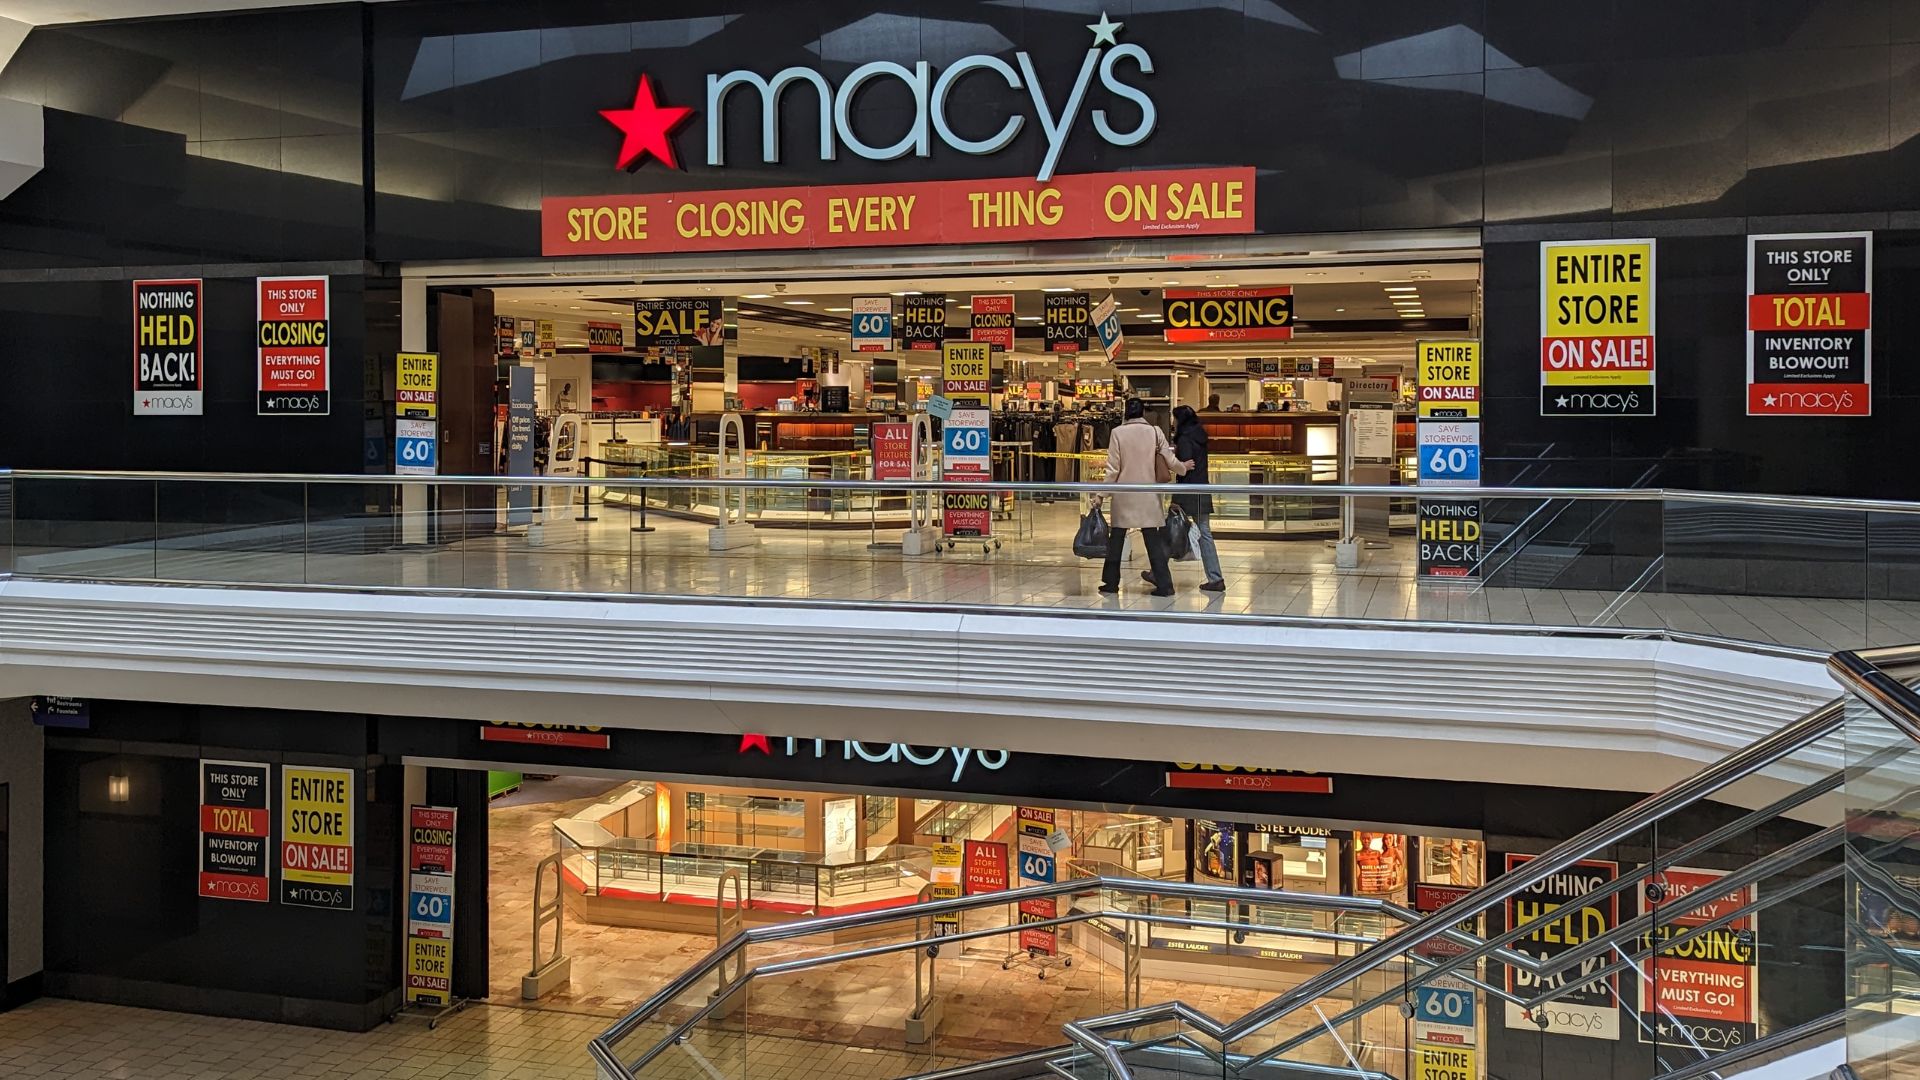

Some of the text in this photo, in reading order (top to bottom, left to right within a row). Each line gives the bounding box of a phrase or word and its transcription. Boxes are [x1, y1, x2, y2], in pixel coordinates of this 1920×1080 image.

[707, 12, 1156, 182] macy's
[567, 181, 1243, 242] STORE CLOSING EVERY THING ON SALE
[1767, 250, 1852, 265] THIS STORE
[1556, 254, 1642, 284] ENTIRE
[1787, 268, 1831, 282] ONLY
[140, 292, 194, 310] NOTHING
[268, 288, 317, 300] THIS STORE
[1046, 296, 1086, 306] NOTHING
[280, 303, 305, 313] ONLY
[636, 300, 710, 311] ENTIRE STORE ON
[906, 298, 944, 306] NOTHING
[906, 308, 944, 323] HELD
[1047, 308, 1088, 324] HELD
[1168, 298, 1288, 328] CLOSING
[1558, 294, 1639, 325] STORE
[1773, 297, 1845, 327] TOTAL
[636, 310, 710, 336] SALE
[974, 314, 1012, 328] CLOSING
[140, 314, 194, 346] HELD
[261, 322, 326, 346] CLOSING
[589, 328, 621, 345] CLOSING
[906, 326, 944, 338] BACK!
[1047, 326, 1087, 339] BACK!
[1215, 329, 1246, 338] macy's
[1765, 337, 1853, 351] INVENTORY
[950, 348, 984, 360] ENTIRE
[1426, 347, 1472, 362] ENTIRE
[1548, 338, 1648, 368] ON SALE!
[140, 352, 194, 382] BACK!
[266, 355, 320, 366] EVERYTHING
[402, 358, 432, 371] ENTIRE
[1769, 356, 1849, 370] BLOWOUT!
[270, 370, 315, 380] MUST GO!
[950, 363, 983, 376] STORE
[1428, 365, 1470, 381] STORE
[403, 374, 432, 386] STORE
[947, 380, 987, 391] ON SALE!
[1350, 381, 1388, 390] Directory
[400, 391, 434, 402] ON SALE!
[1423, 386, 1474, 400] ON SALE!
[152, 396, 192, 411] macy's
[276, 395, 320, 412] macy's
[1571, 391, 1639, 412] macy's
[1780, 390, 1853, 412] macy's
[400, 430, 433, 438] STOREWIDE
[885, 429, 909, 440] ALL
[1438, 425, 1460, 433] SAVE
[1425, 434, 1473, 443] STOREWIDE
[884, 442, 907, 450] STORE
[879, 451, 912, 459] FIXTURES
[1430, 448, 1475, 472] 60%
[946, 494, 988, 509] CLOSING
[1420, 505, 1478, 517] NOTHING
[1421, 520, 1480, 541] HELD
[1422, 544, 1480, 562] BACK!
[210, 773, 258, 786] THIS STORE
[1233, 776, 1271, 788] macy's
[221, 787, 247, 799] ONLY
[291, 778, 344, 803] ENTIRE
[213, 808, 254, 833] TOTAL
[431, 812, 449, 820] STORE
[1021, 808, 1052, 820] ON SALE!
[292, 810, 342, 836] STORE
[414, 828, 452, 845] CLOSING
[1288, 826, 1332, 836] LAUDER
[209, 838, 258, 852] INVENTORY
[1030, 838, 1043, 846] SAVE
[286, 844, 348, 871] ON SALE!
[417, 846, 449, 855] EVERYTHING
[975, 846, 997, 858] ALL
[211, 853, 256, 866] BLOWOUT!
[974, 859, 996, 867] STORE
[970, 867, 1000, 876] FIXTURES
[216, 880, 258, 897] macy's
[416, 884, 448, 893] STOREWIDE
[300, 887, 342, 905] macy's
[1031, 906, 1044, 914] ONLY
[1517, 900, 1606, 945] HELD
[415, 944, 446, 958] ENTIRE
[1185, 943, 1209, 951] LAUDER
[1427, 942, 1446, 950] MUST
[1280, 951, 1302, 960] LAUDER
[415, 958, 444, 973] STORE
[411, 976, 447, 989] ON SALE!
[1661, 988, 1735, 1006] MUST GO!
[1670, 1022, 1740, 1048] macy's
[1424, 1050, 1468, 1068] ENTIRE
[1424, 1068, 1466, 1080] STORE
